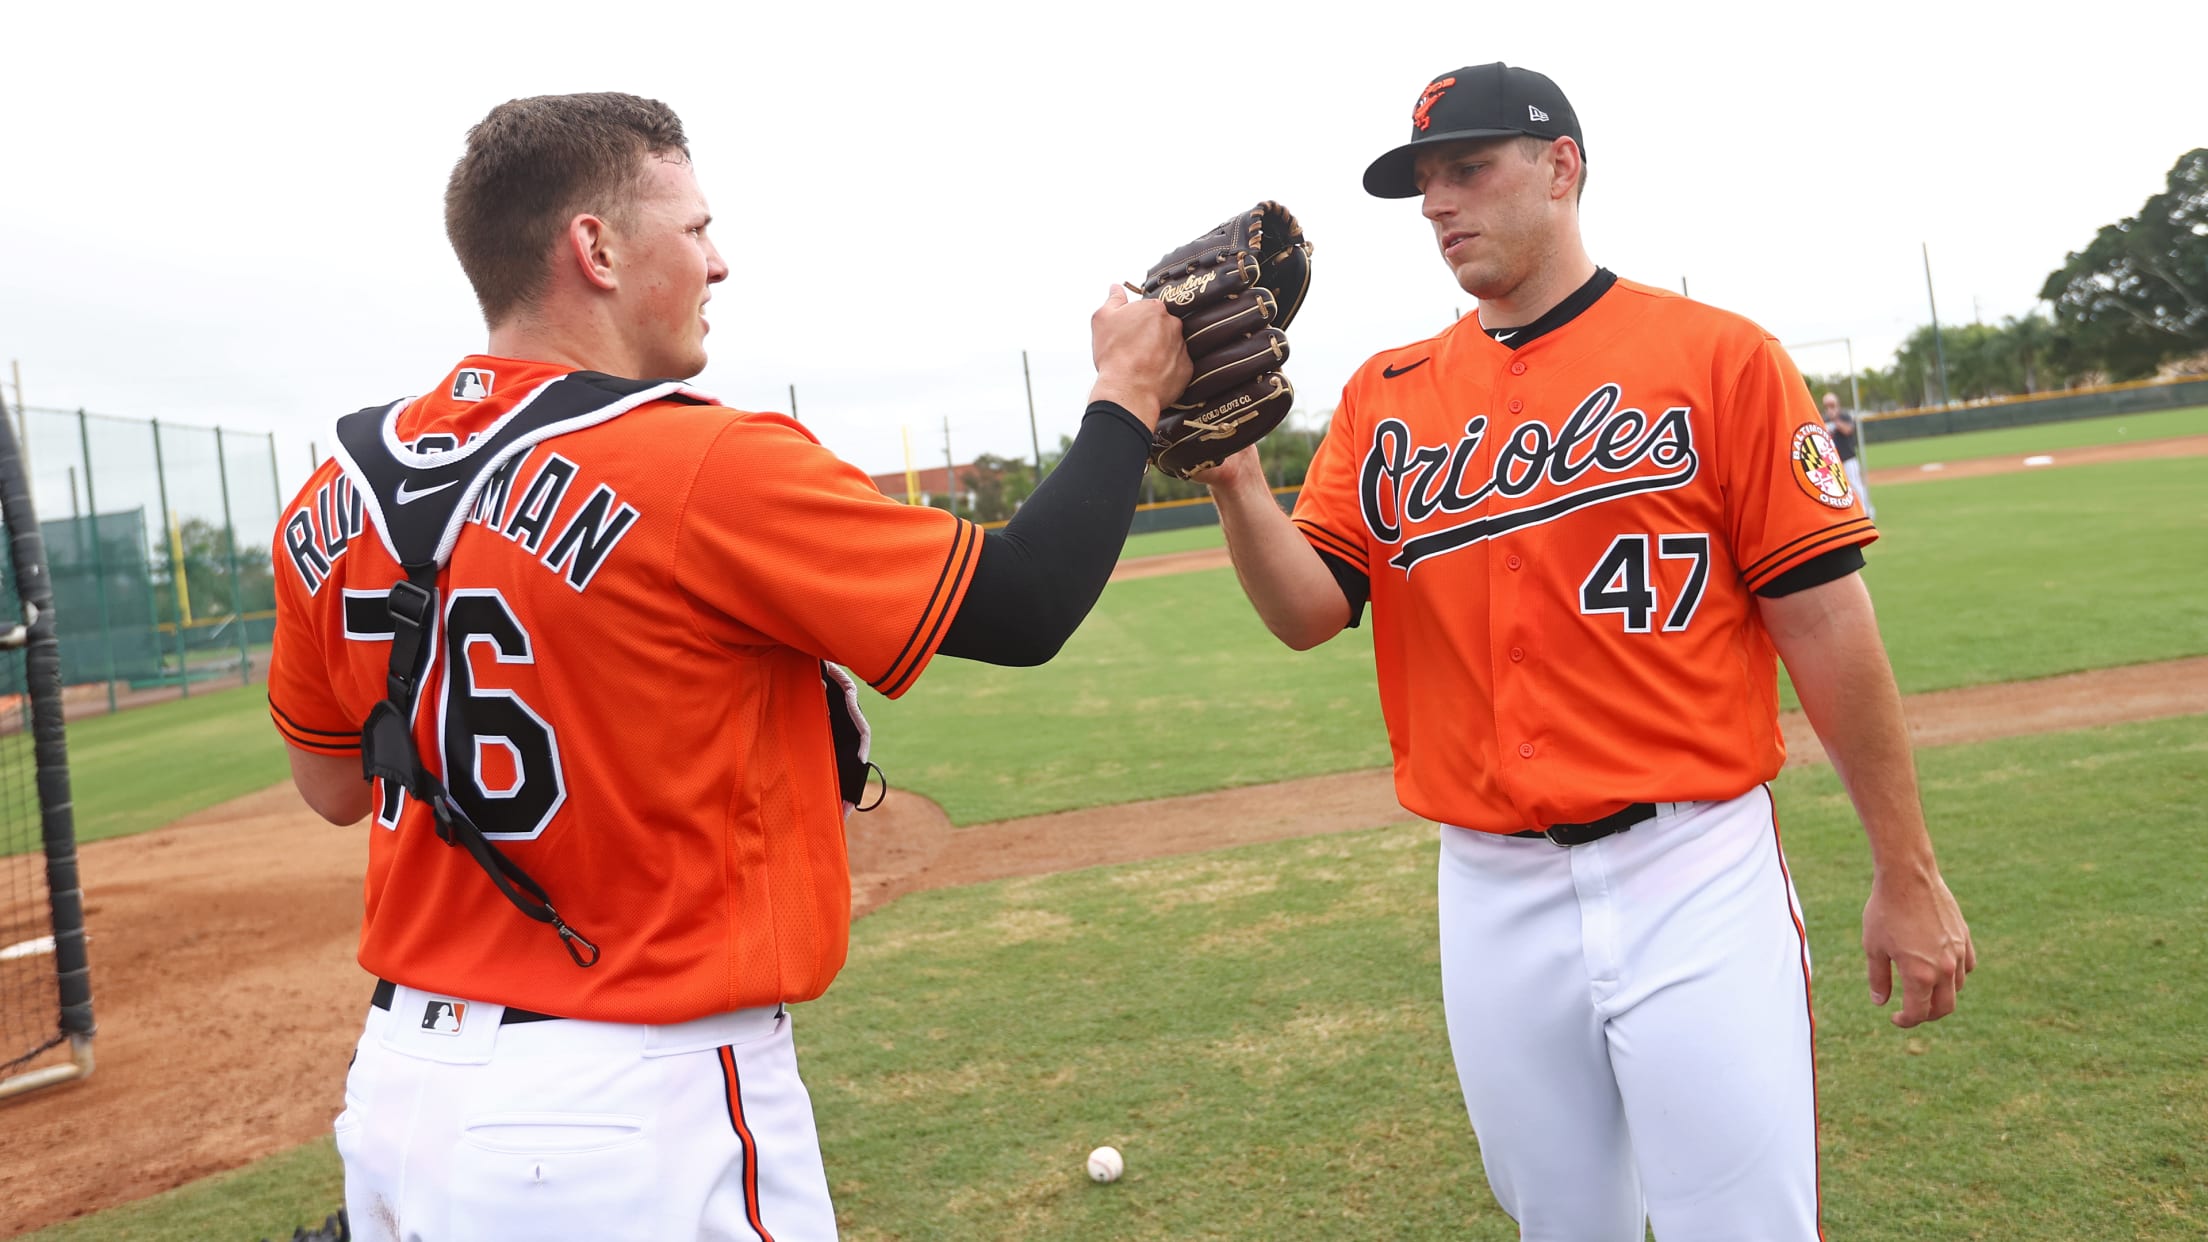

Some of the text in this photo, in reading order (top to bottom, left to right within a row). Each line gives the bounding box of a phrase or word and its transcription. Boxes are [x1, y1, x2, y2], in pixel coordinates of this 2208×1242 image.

[1158, 270, 1217, 302] Rawlings
[1202, 408, 1220, 422] GOLD
[1219, 399, 1240, 414] GLOVE
[1239, 394, 1252, 405] CO.
[1357, 382, 1698, 545] Orioles
[1579, 532, 1710, 634] 47
